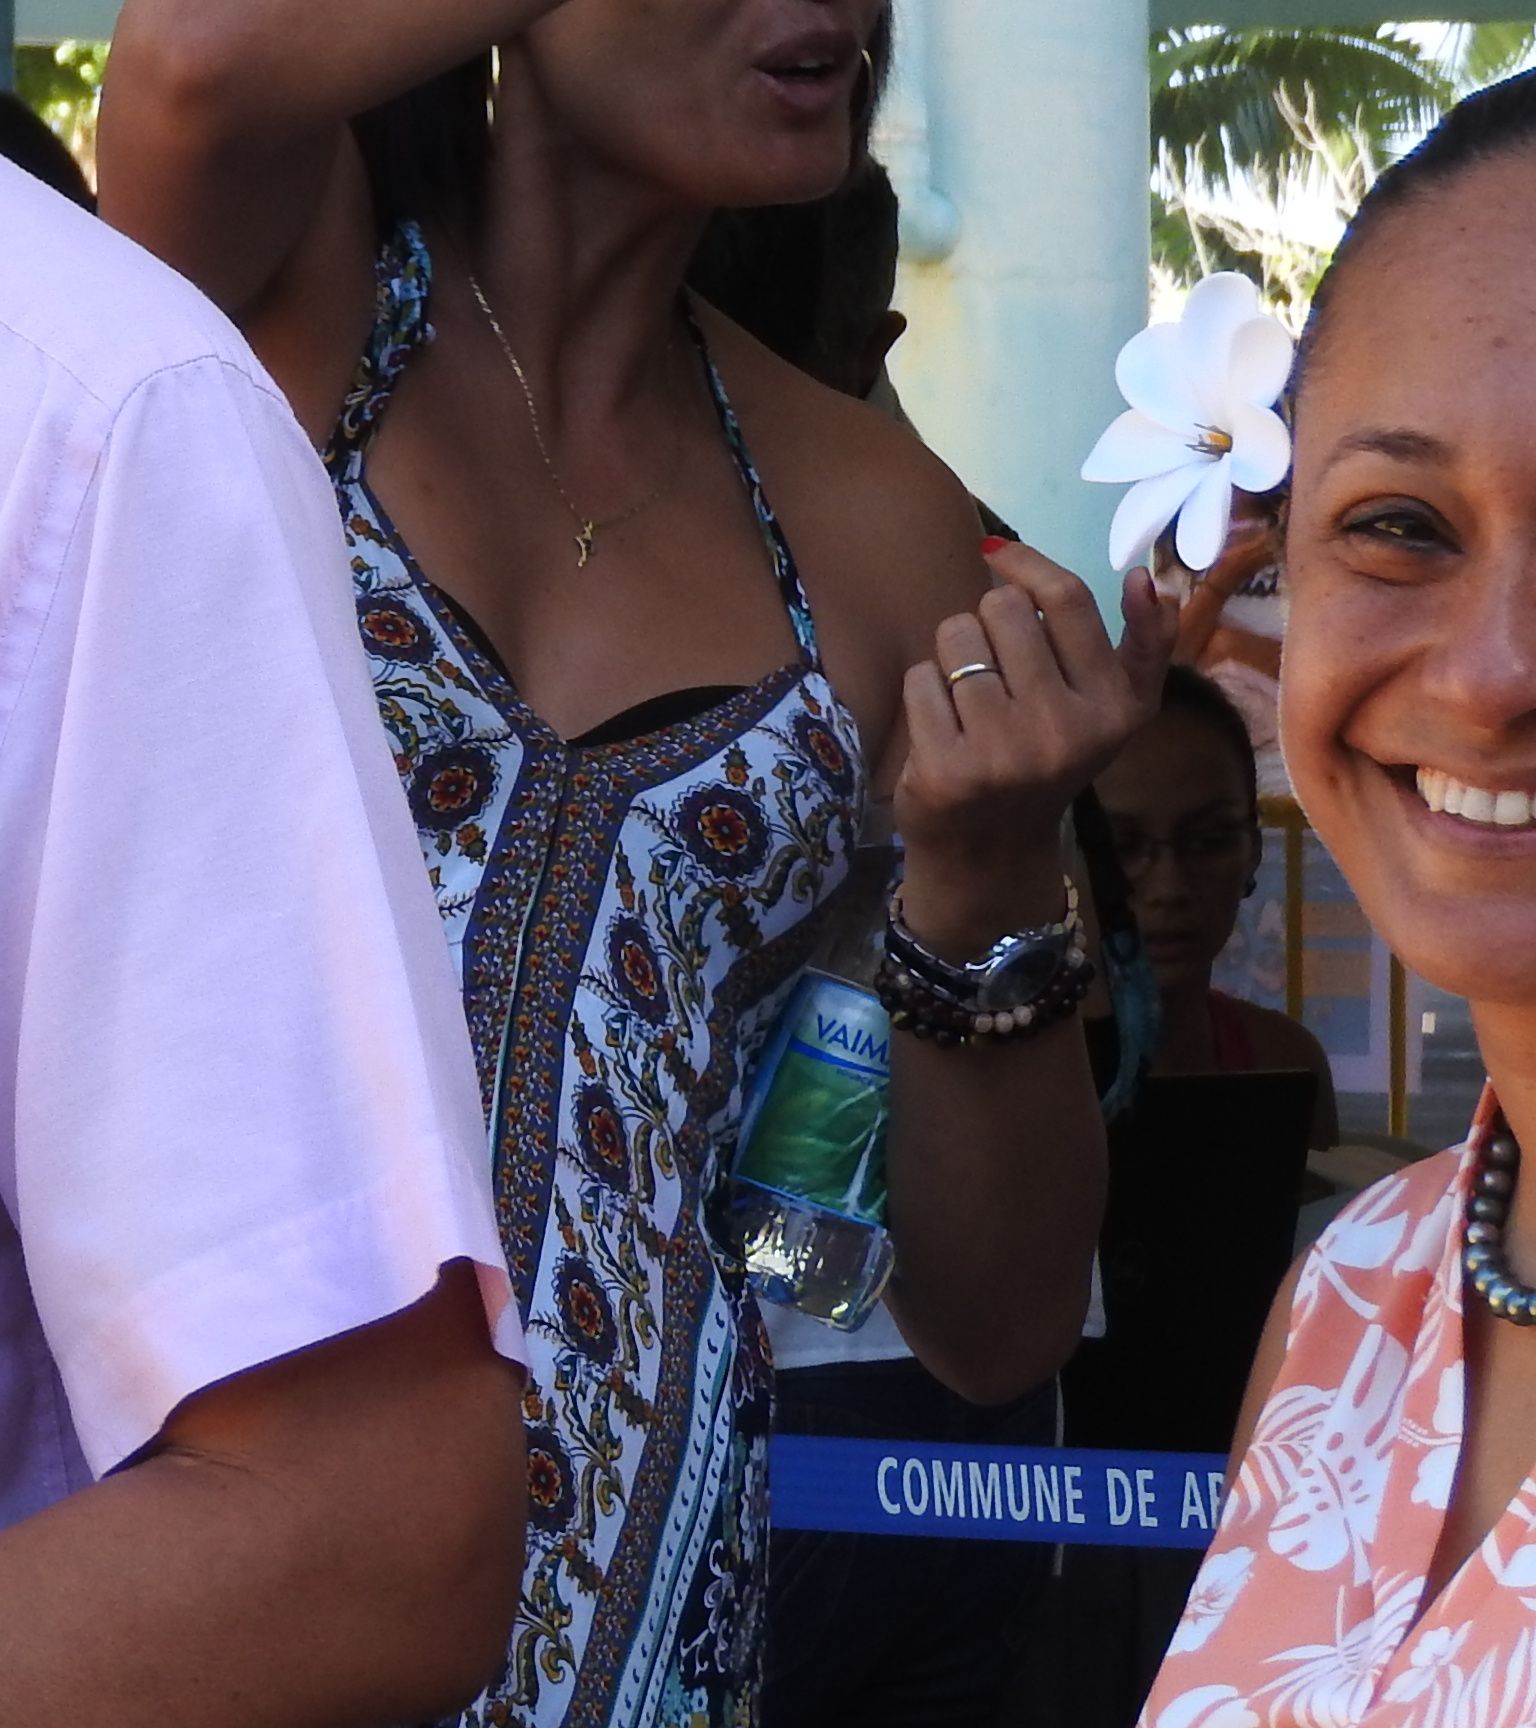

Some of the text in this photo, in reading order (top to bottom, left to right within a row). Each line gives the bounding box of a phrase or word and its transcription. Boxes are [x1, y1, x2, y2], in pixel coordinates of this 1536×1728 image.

[817, 1013, 889, 1065] VAIM
[876, 1455, 1087, 1526] COMMUNE
[1106, 1465, 1161, 1529] DE
